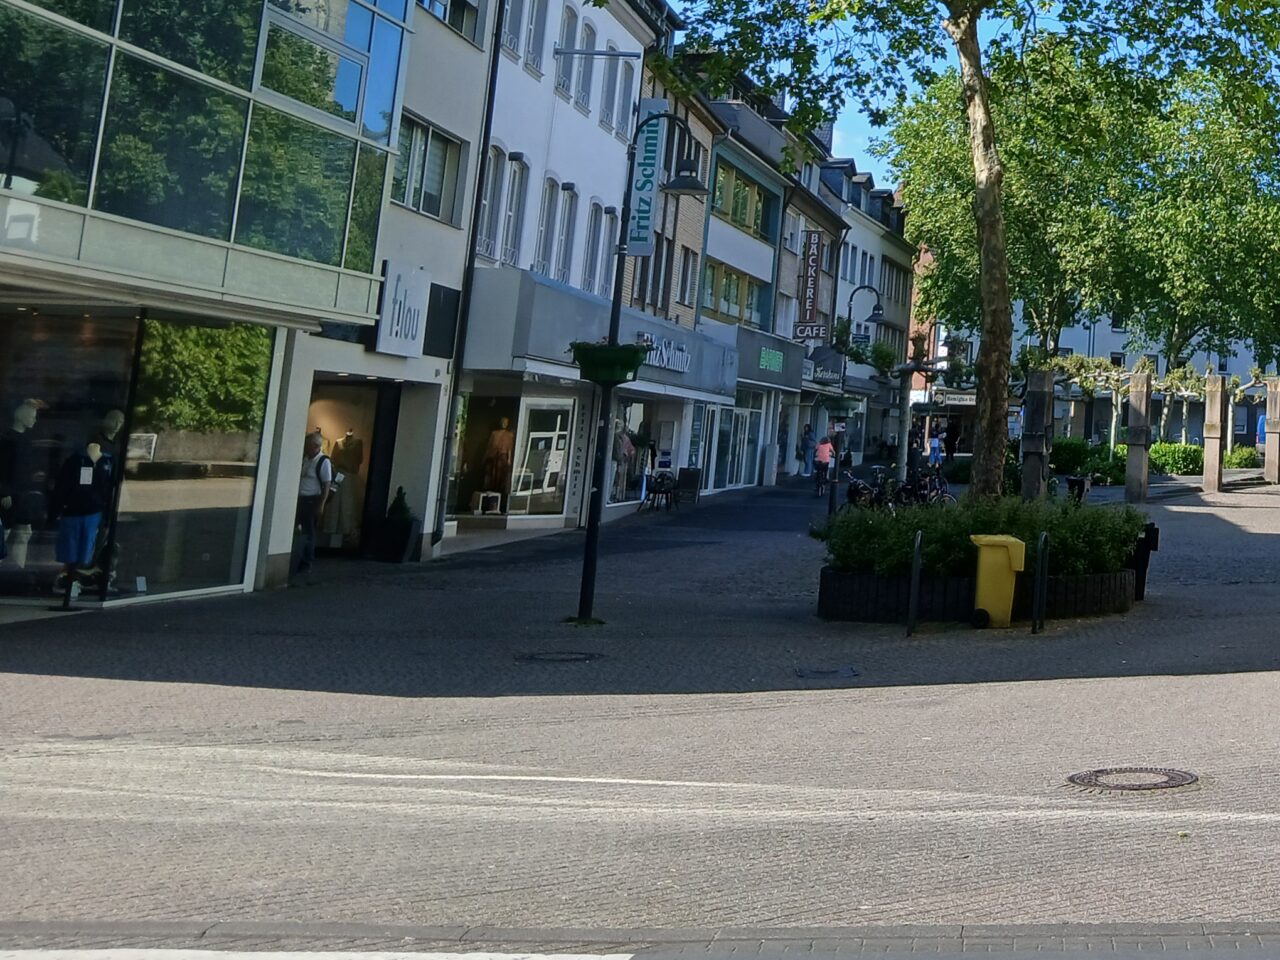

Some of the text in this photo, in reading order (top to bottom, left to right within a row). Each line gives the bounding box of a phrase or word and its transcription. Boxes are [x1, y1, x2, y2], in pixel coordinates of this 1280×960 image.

[629, 110, 660, 243] Fritz Schmitz
[805, 233, 819, 320] BÄCKEREI
[660, 338, 691, 373] Schmitz
[796, 326, 826, 337] CAFE
